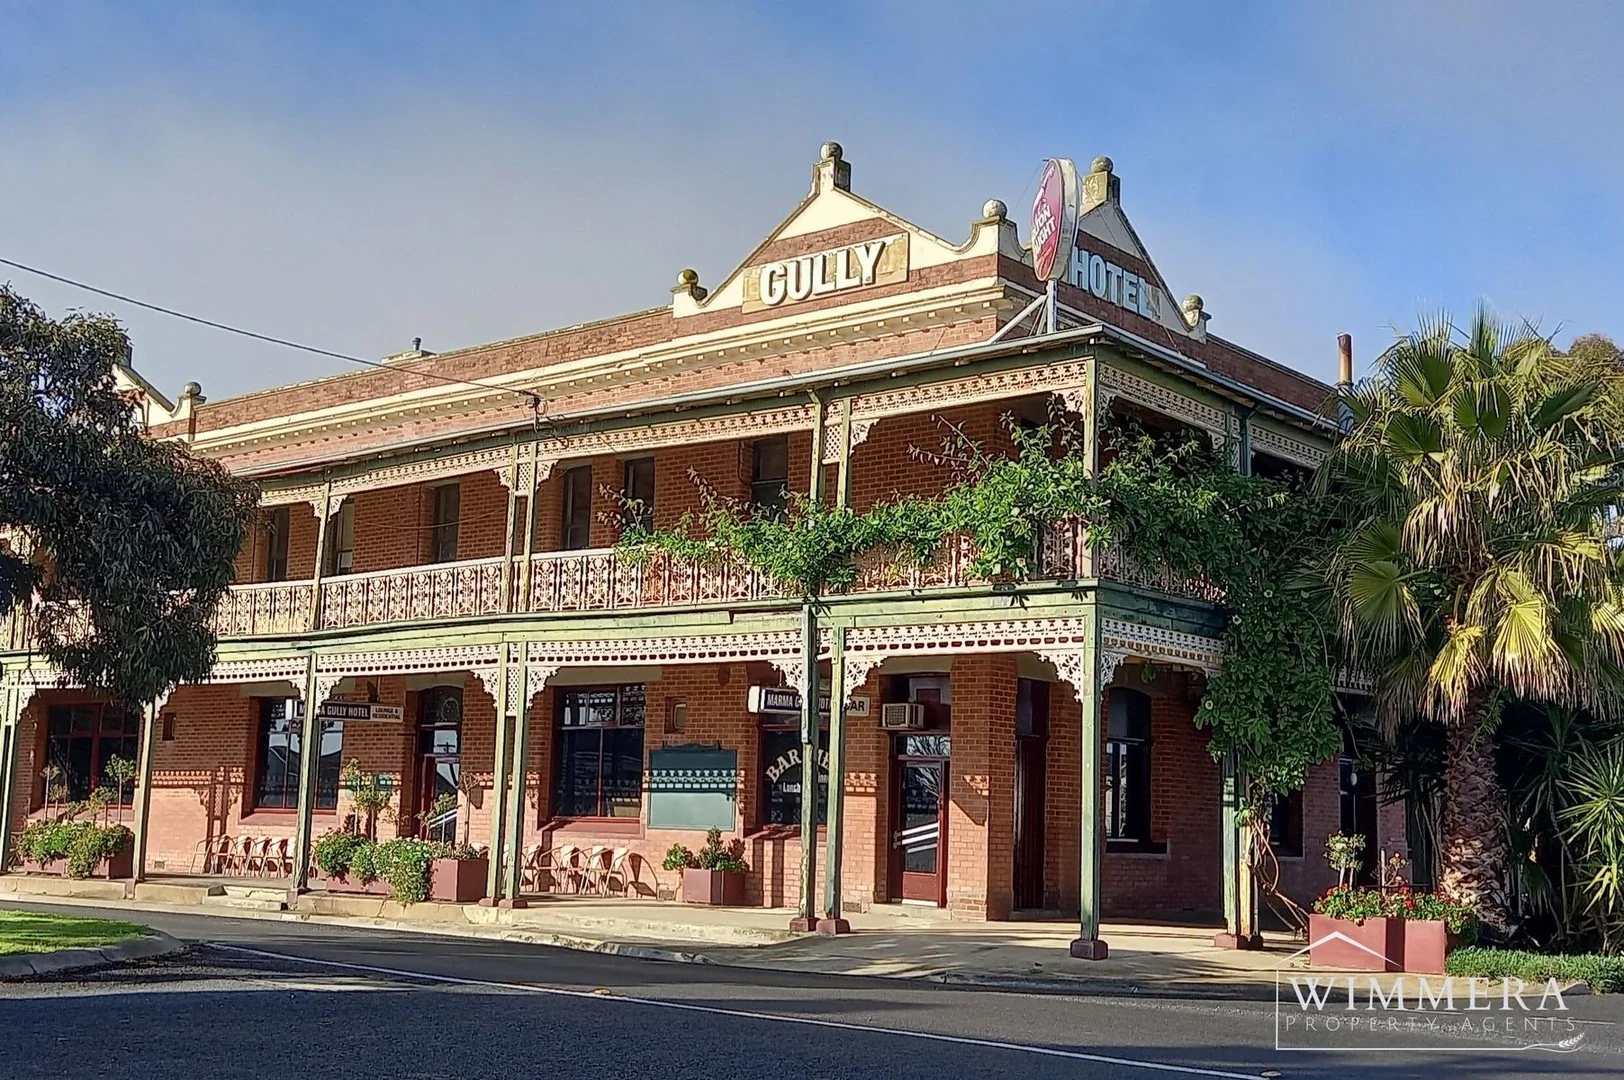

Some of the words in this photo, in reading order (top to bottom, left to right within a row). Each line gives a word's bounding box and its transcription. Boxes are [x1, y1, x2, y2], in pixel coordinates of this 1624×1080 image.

[760, 241, 884, 306] GULLY
[1071, 246, 1152, 320] HOTEL
[327, 705, 347, 716] GULLY
[348, 706, 369, 718] HOTEL
[766, 693, 793, 707] MARMA
[765, 748, 802, 783] BAR
